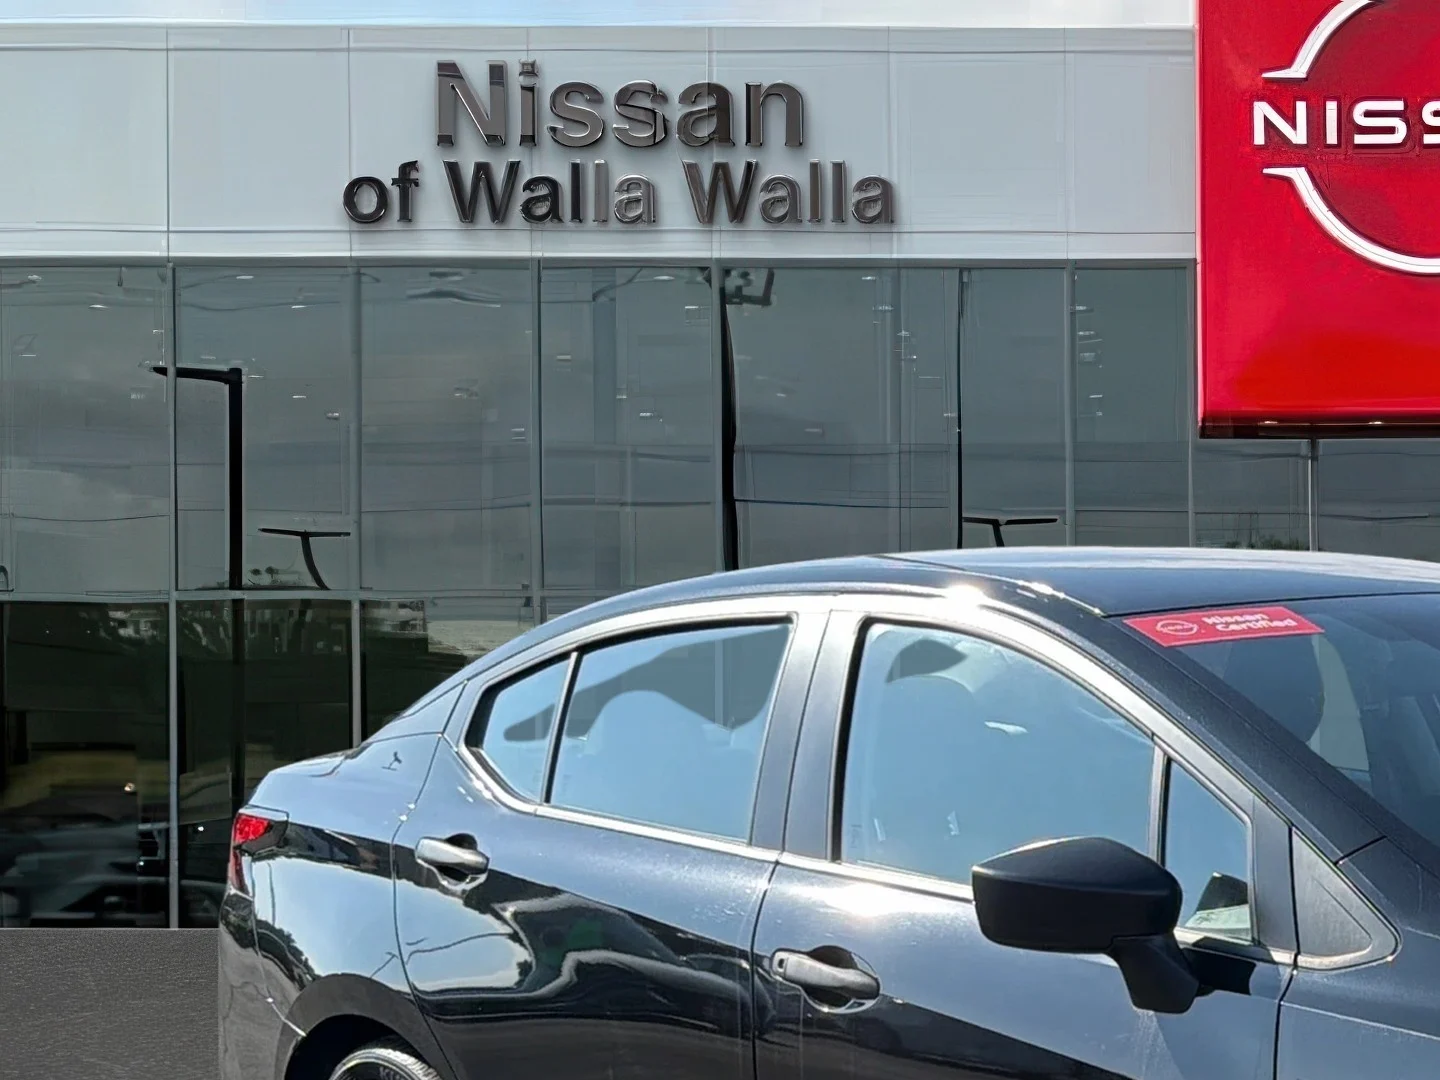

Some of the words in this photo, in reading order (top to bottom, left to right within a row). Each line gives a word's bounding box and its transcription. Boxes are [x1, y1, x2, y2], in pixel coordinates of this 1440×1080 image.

[435, 58, 806, 148] Nissan
[341, 159, 420, 224] of
[442, 158, 658, 225] Walla
[681, 158, 896, 225] Walla
[1201, 613, 1270, 625] Nissan
[1215, 618, 1298, 632] Certified
